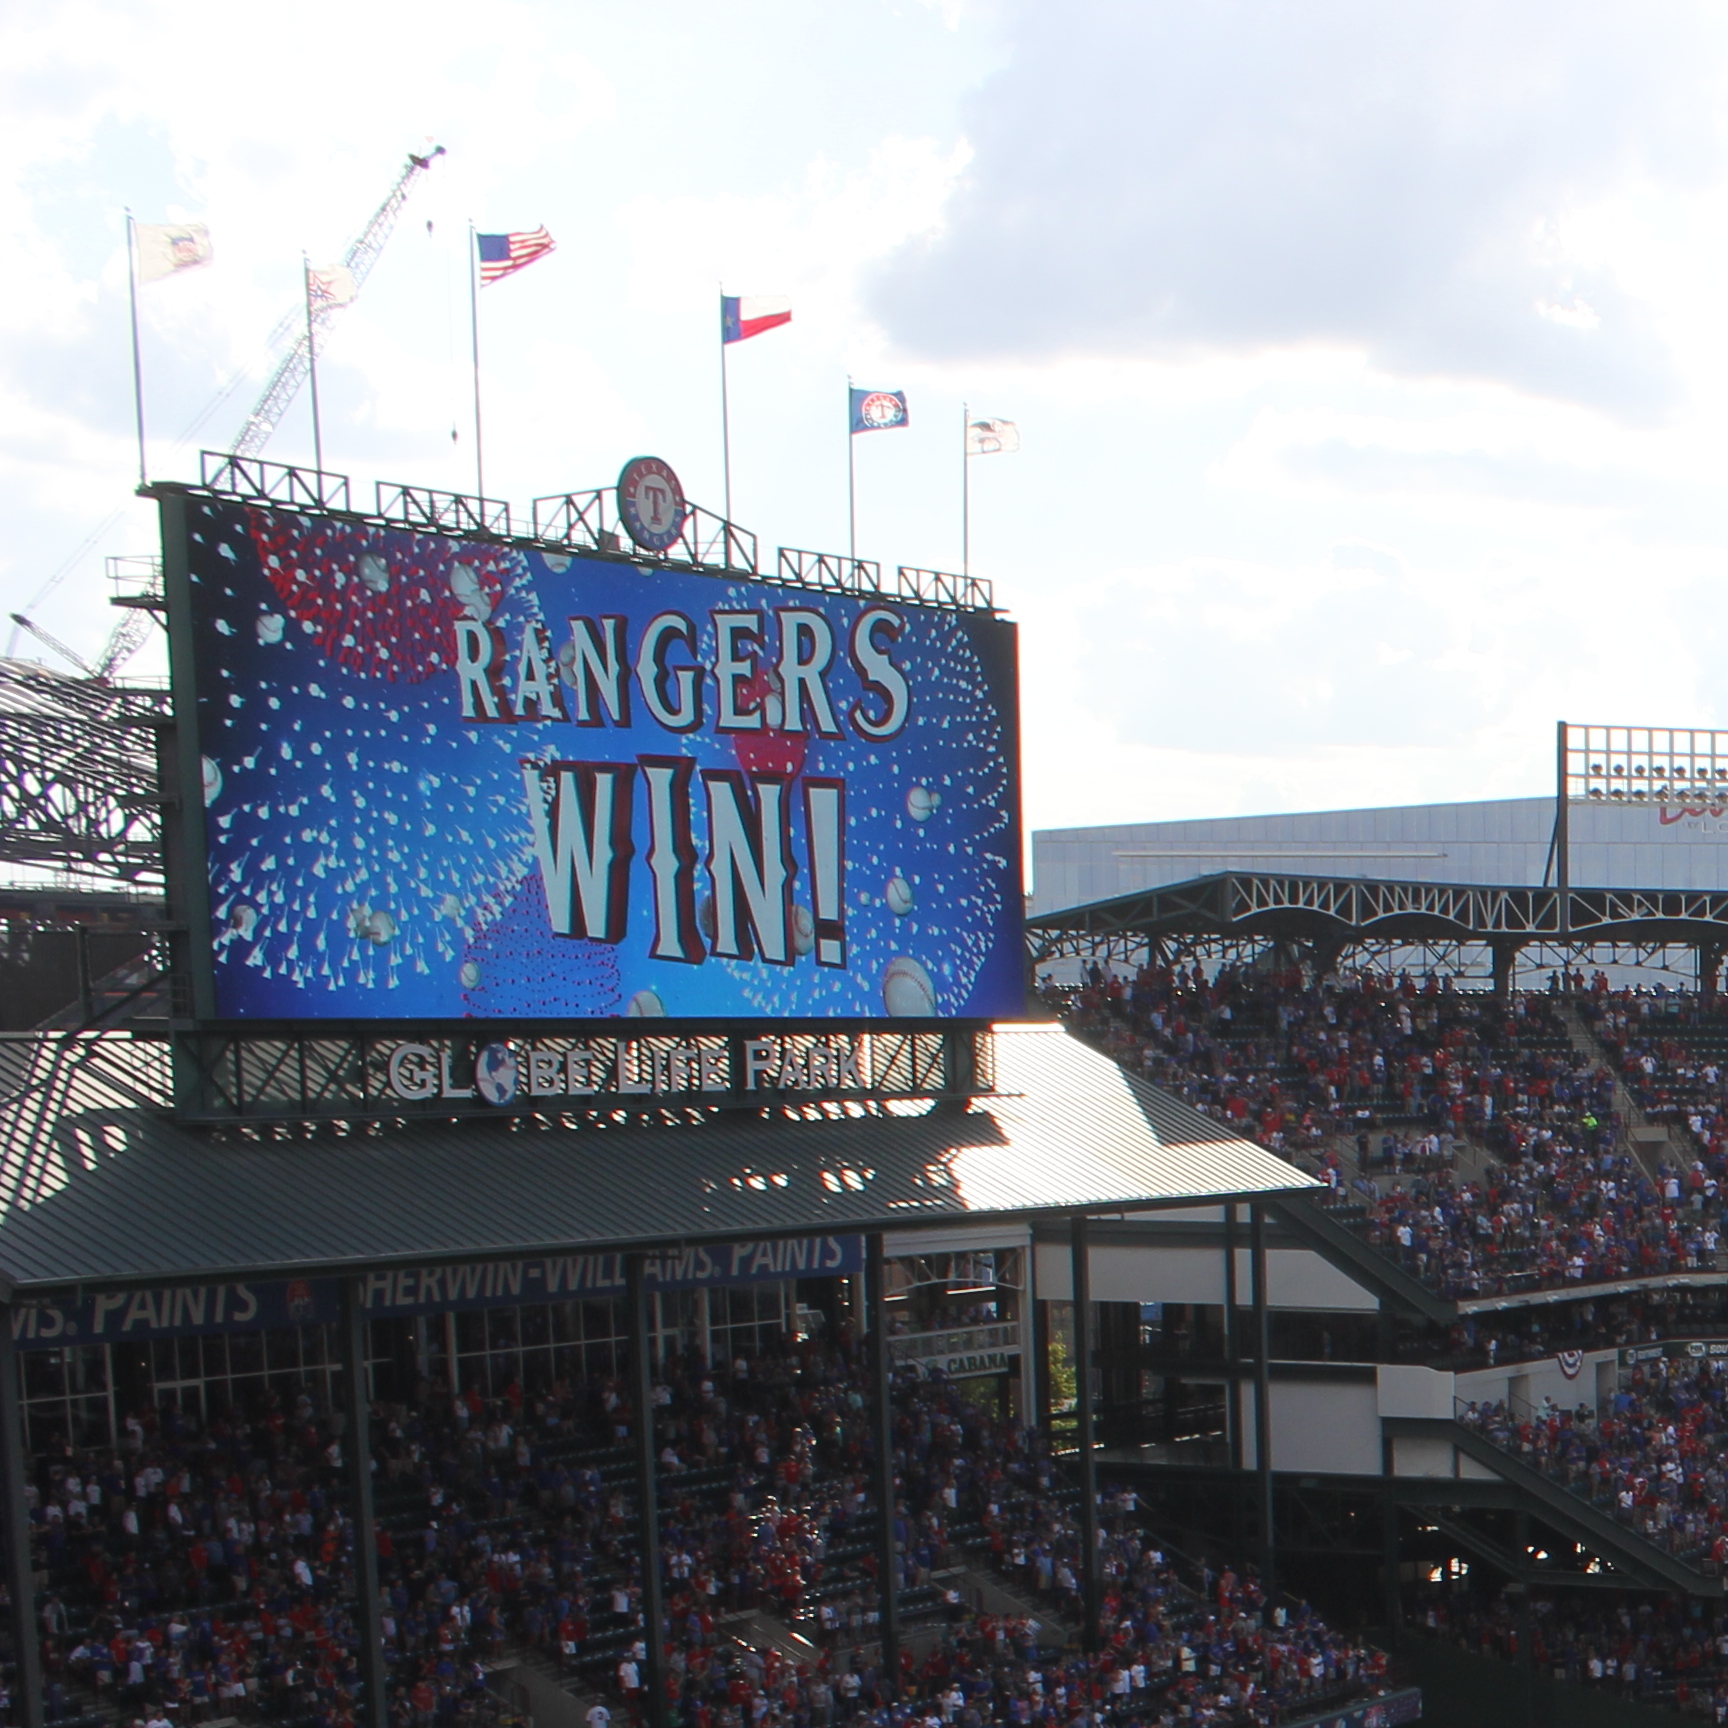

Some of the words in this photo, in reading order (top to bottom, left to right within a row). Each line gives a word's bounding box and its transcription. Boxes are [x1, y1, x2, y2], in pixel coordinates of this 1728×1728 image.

[644, 485, 667, 526] T
[453, 605, 912, 742] RANGERS
[520, 753, 846, 969] WIN!
[616, 1042, 727, 1095] LIFE
[744, 1039, 871, 1091] PARK
[730, 1236, 842, 1277] PAINTS
[93, 1283, 257, 1334] PAINTS
[948, 1353, 1008, 1373] CABANA
